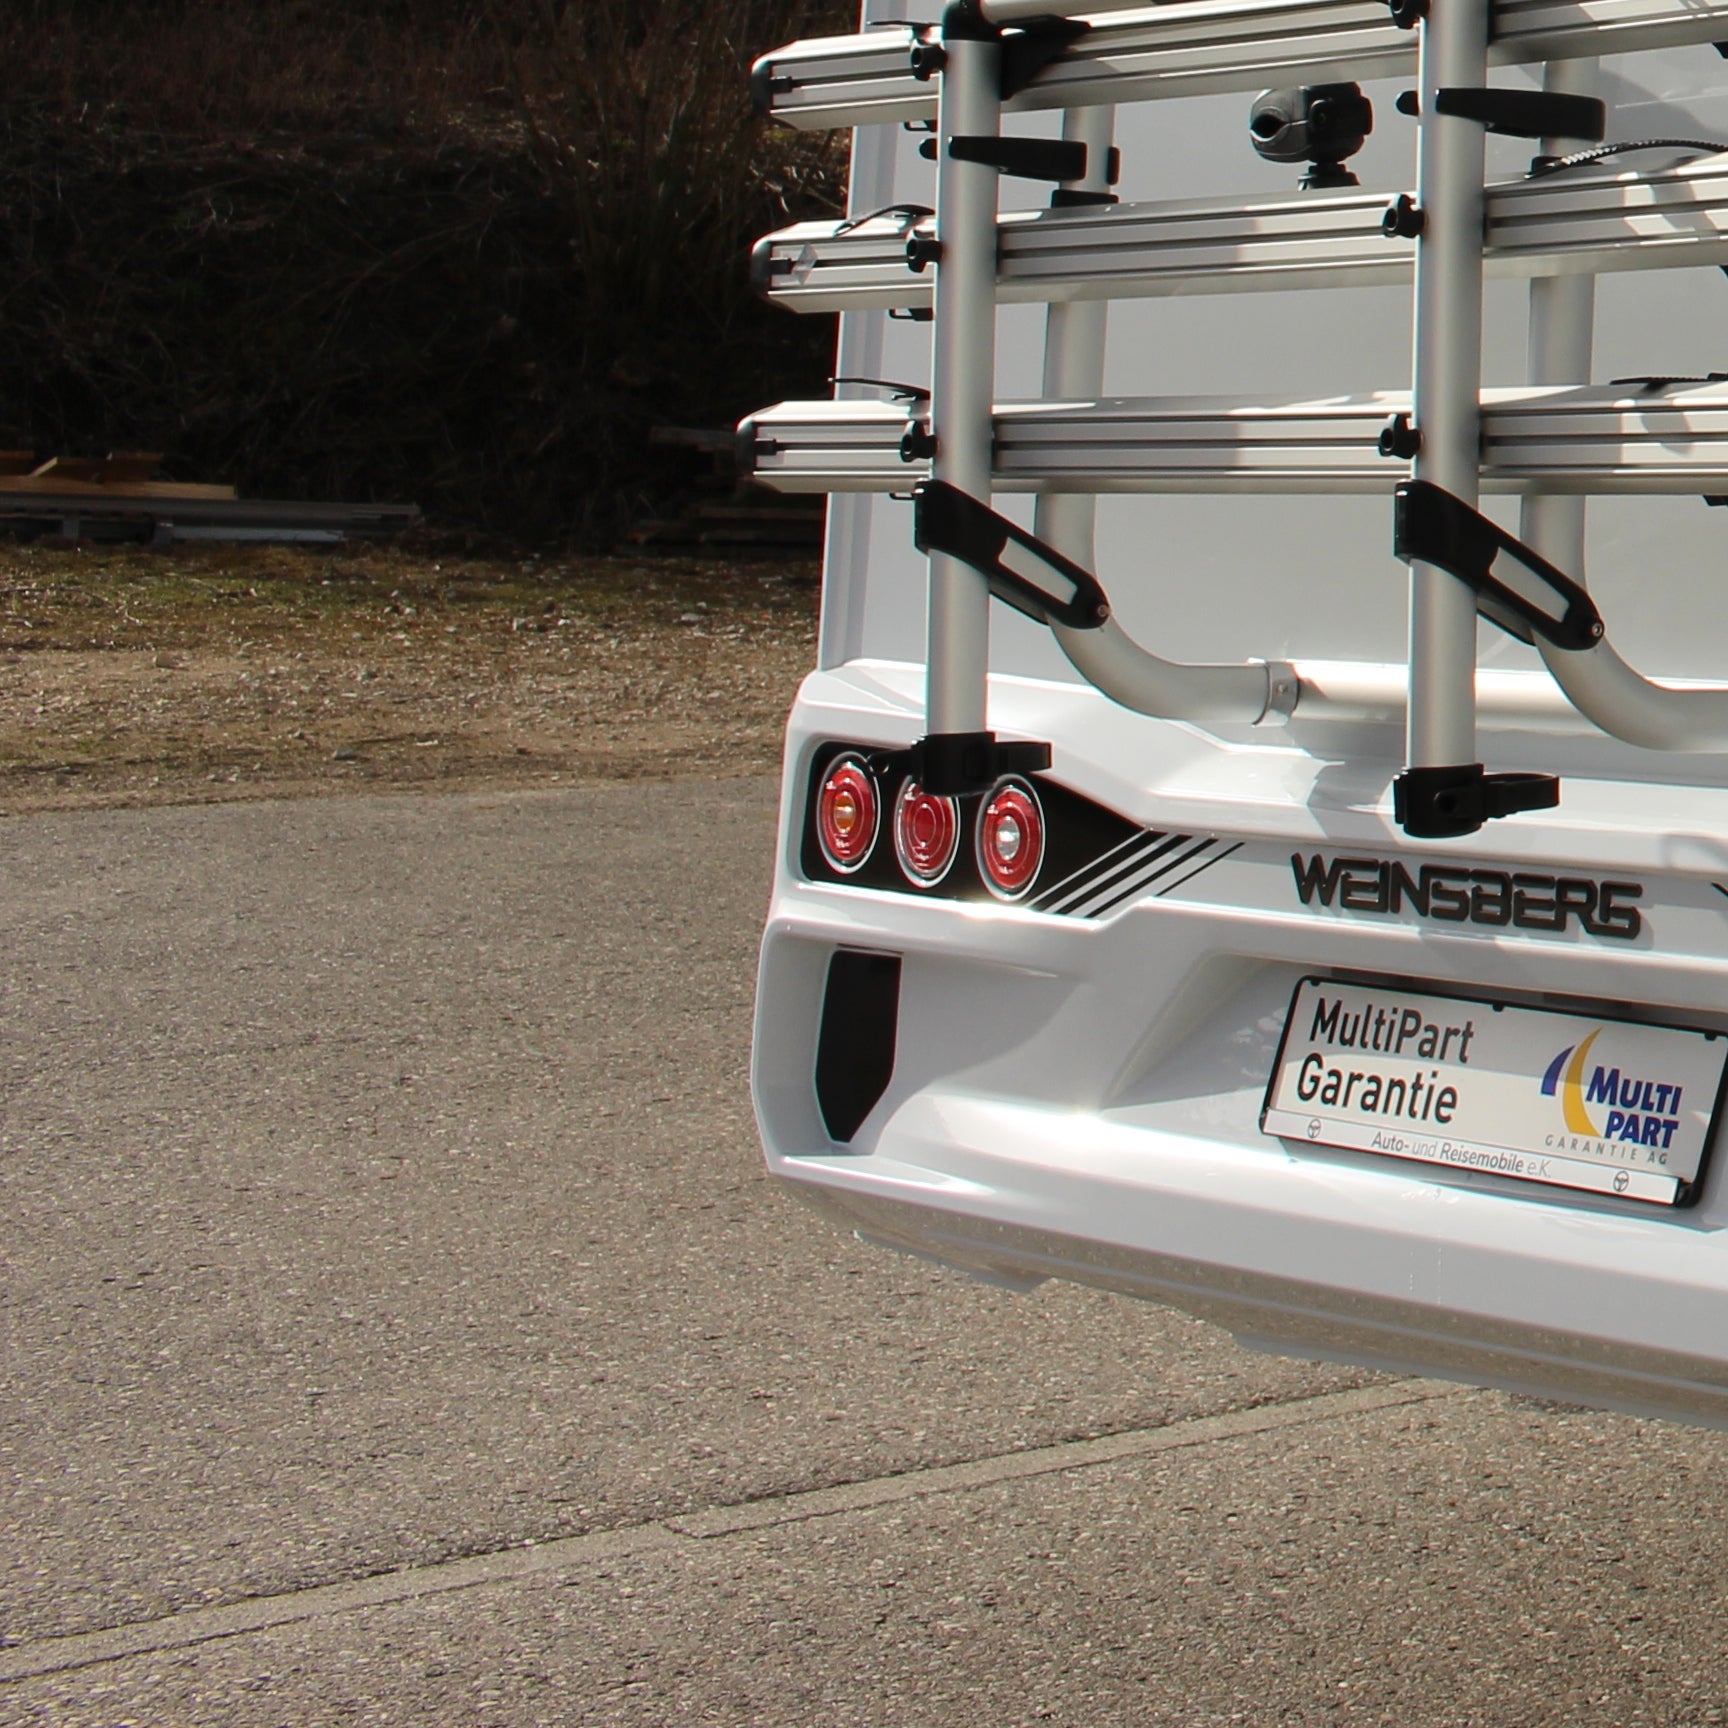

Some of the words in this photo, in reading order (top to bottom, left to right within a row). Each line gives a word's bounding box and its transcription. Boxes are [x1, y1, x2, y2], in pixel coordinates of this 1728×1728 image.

[1291, 852, 1642, 939] WEINSBERG
[1309, 998, 1475, 1063] MultiPart
[1297, 1053, 1458, 1123] Garantie
[1586, 1066, 1683, 1116] MULTI
[1371, 1133, 1410, 1153] Auto-
[1412, 1140, 1438, 1158] und
[1440, 1143, 1524, 1173] Reisemobile
[1527, 1160, 1551, 1177] e.K.
[1545, 1134, 1642, 1160] GARANTIE
[1647, 1151, 1668, 1164] AG
[1604, 1111, 1680, 1149] PART
